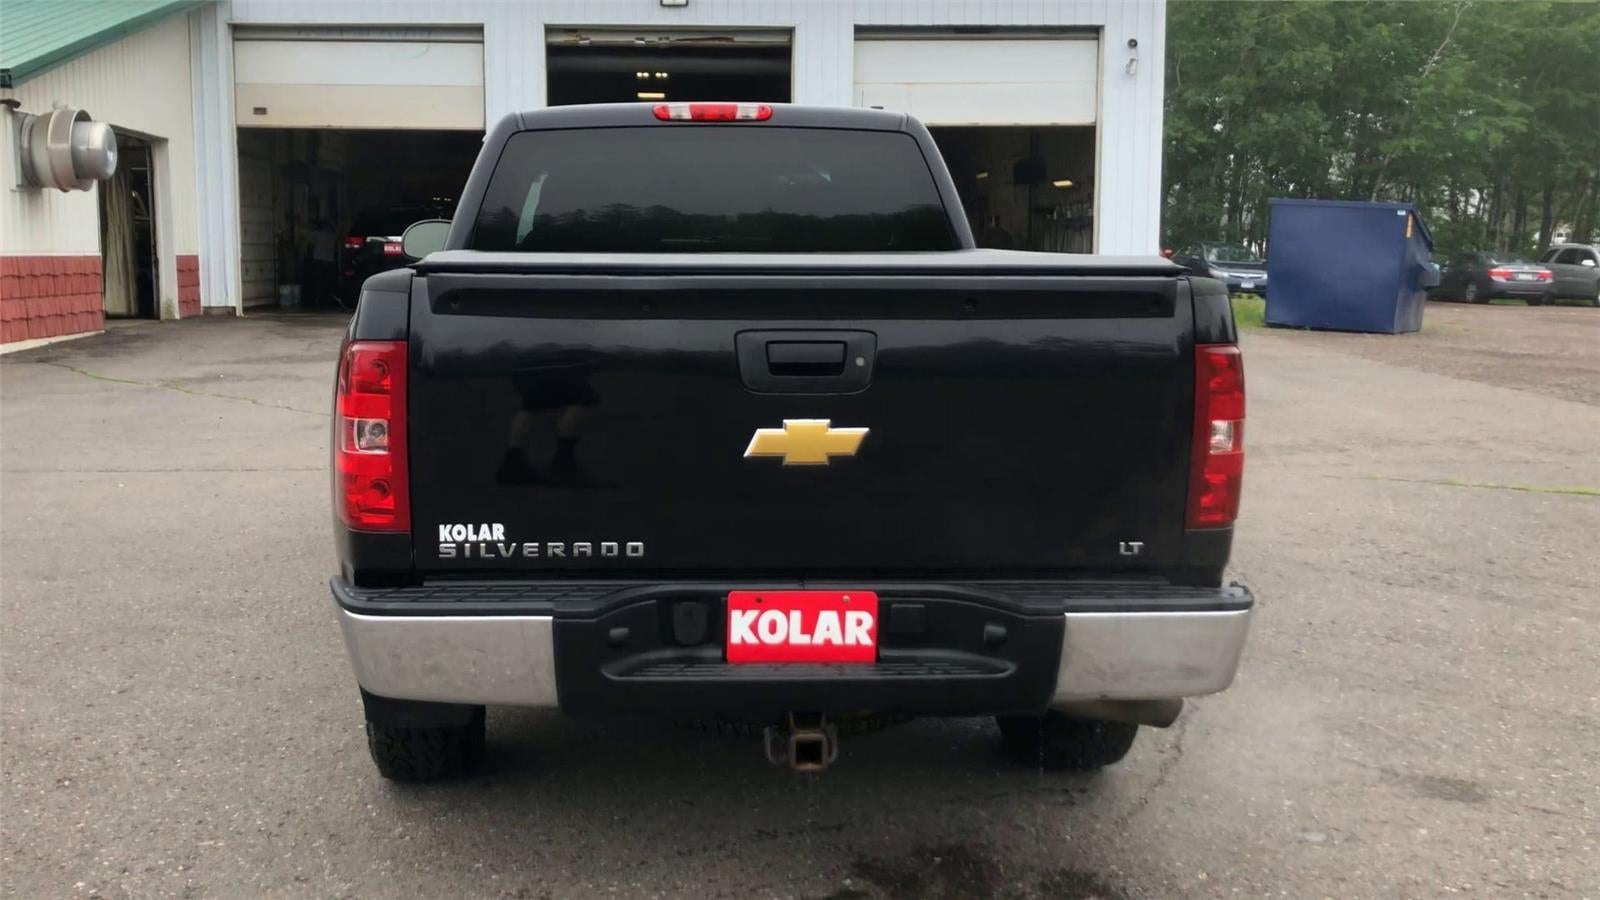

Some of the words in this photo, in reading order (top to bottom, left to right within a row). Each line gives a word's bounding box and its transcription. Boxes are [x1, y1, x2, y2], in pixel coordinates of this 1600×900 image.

[439, 523, 505, 541] KOLAR
[439, 542, 644, 558] SILVERADO
[1119, 541, 1144, 555] LT
[730, 609, 874, 646] KOLAR
